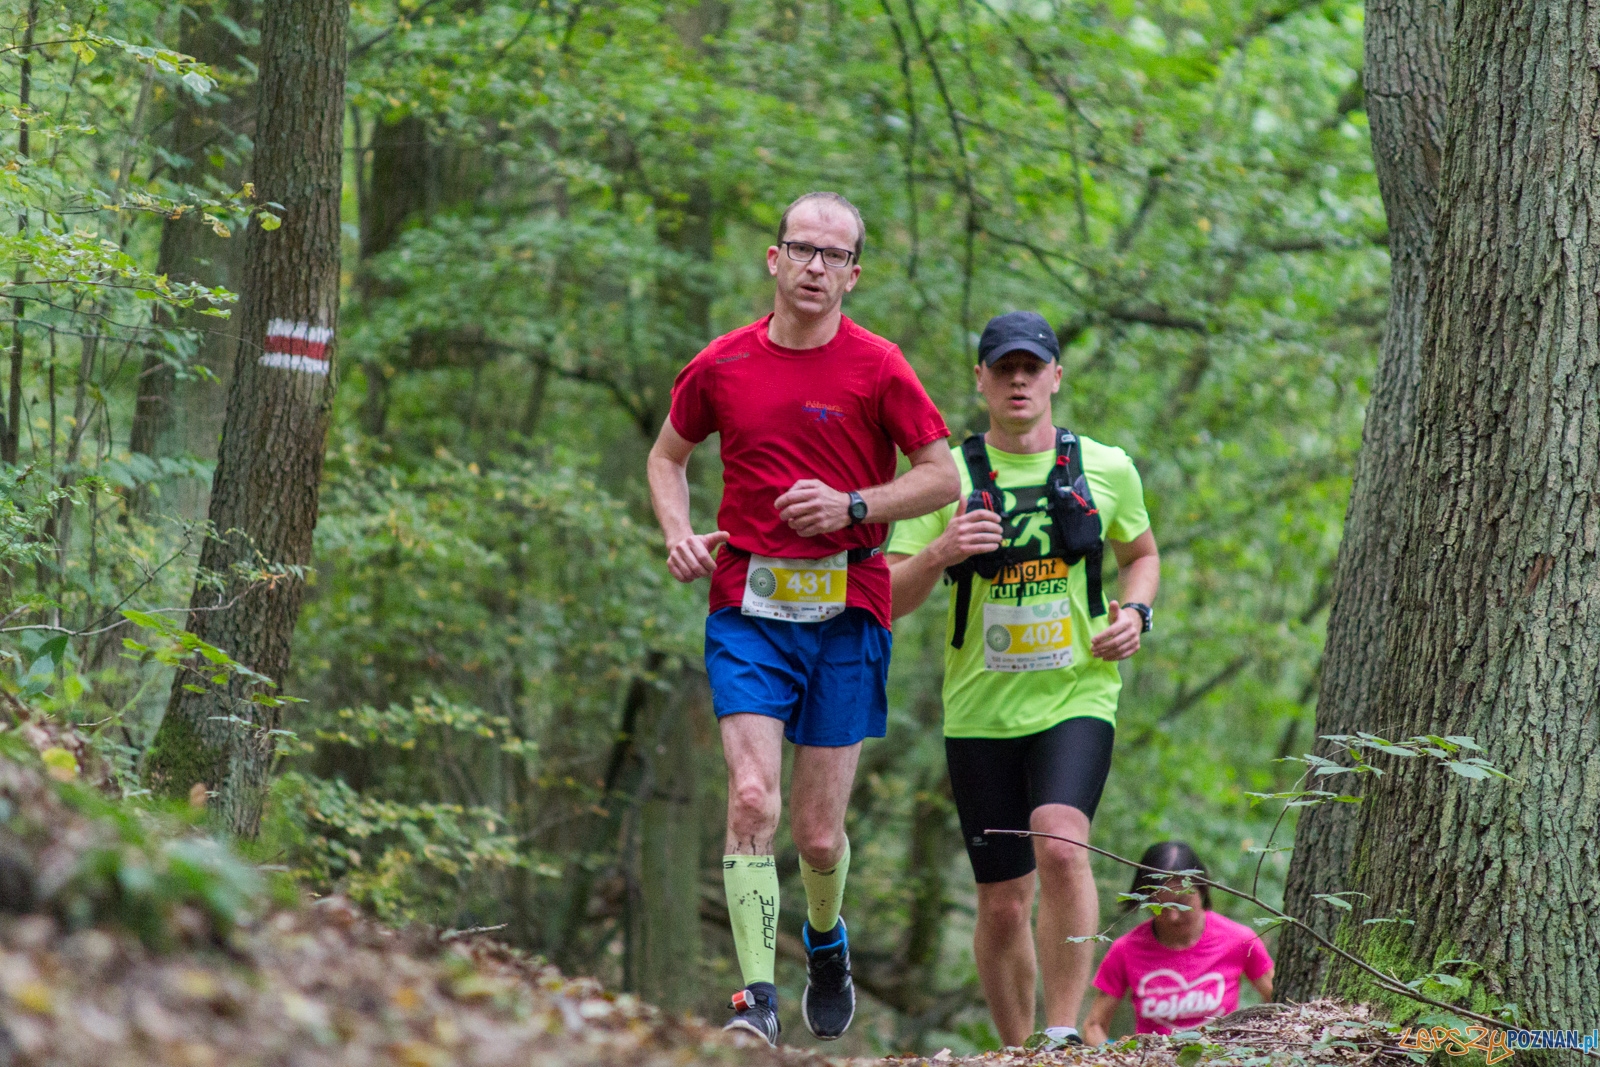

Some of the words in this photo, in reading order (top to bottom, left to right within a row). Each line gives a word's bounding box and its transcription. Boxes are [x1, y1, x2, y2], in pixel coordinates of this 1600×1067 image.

[786, 572, 832, 595] 431
[1021, 621, 1065, 646] 402
[759, 895, 775, 951] FORCE
